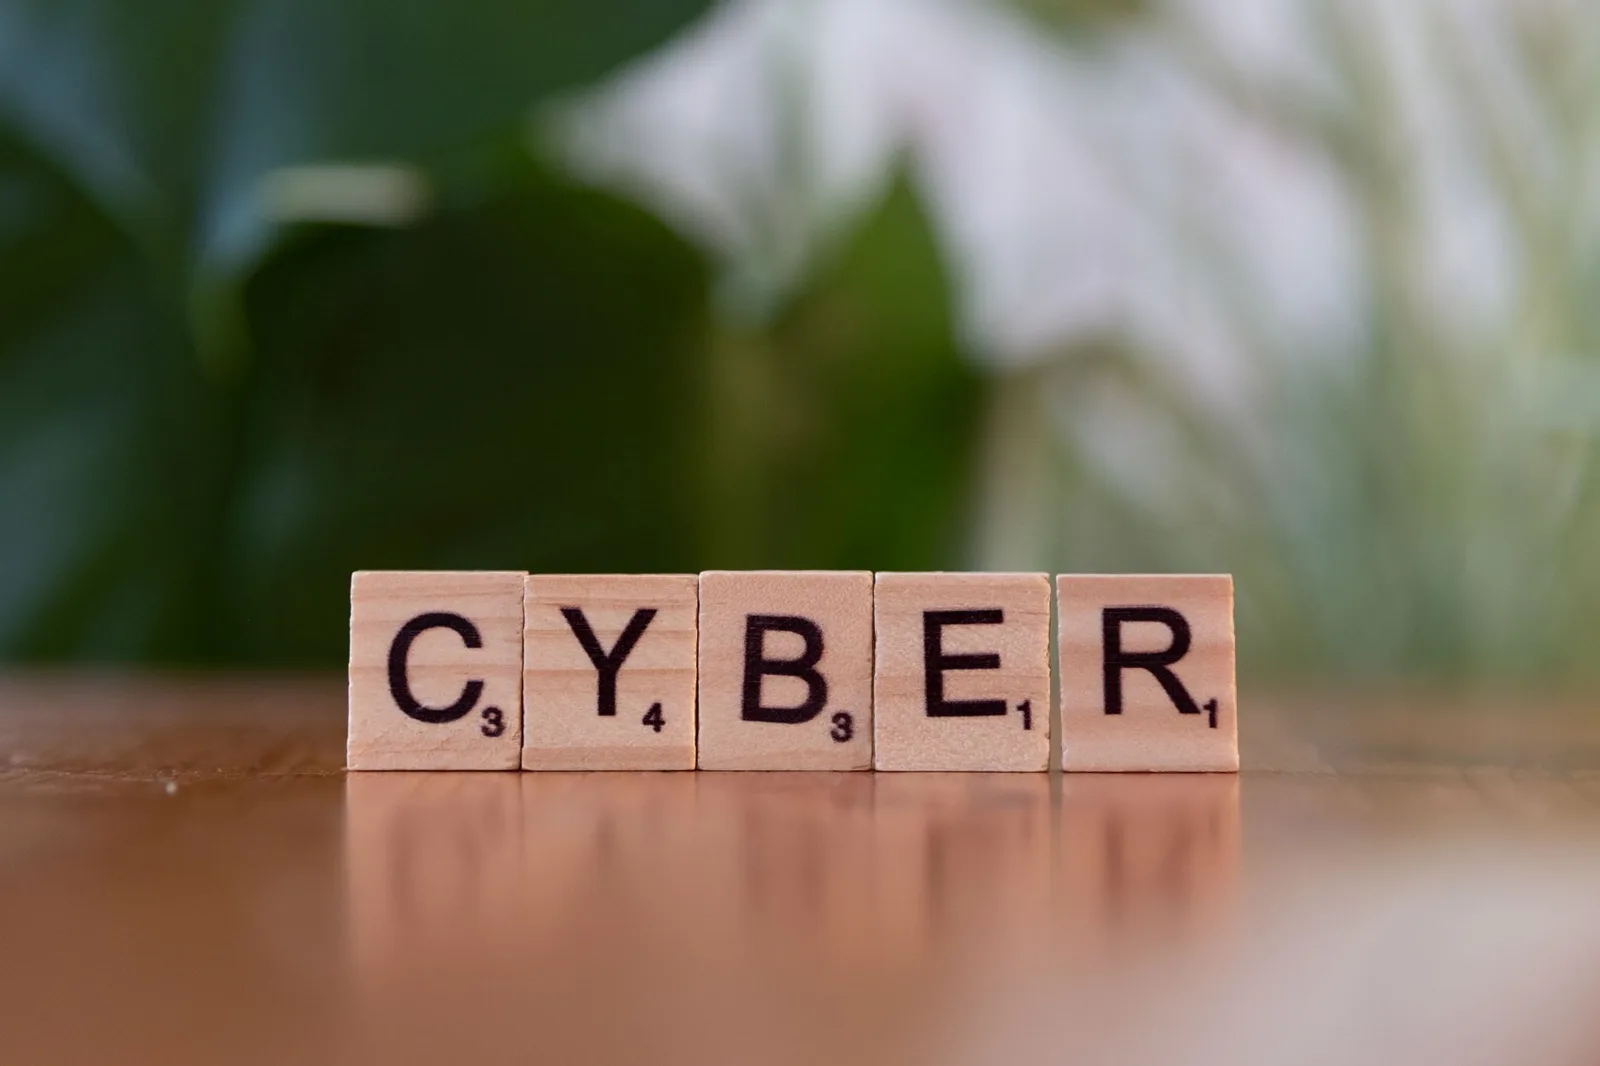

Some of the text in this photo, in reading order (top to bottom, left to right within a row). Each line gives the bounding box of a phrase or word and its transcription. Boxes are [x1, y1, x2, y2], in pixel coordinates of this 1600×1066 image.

[387, 606, 1202, 725] CYBER
[481, 706, 507, 738] 3
[641, 702, 666, 734] 4
[830, 711, 854, 743] 3
[1016, 699, 1032, 731] 1
[1202, 698, 1218, 729] 1
